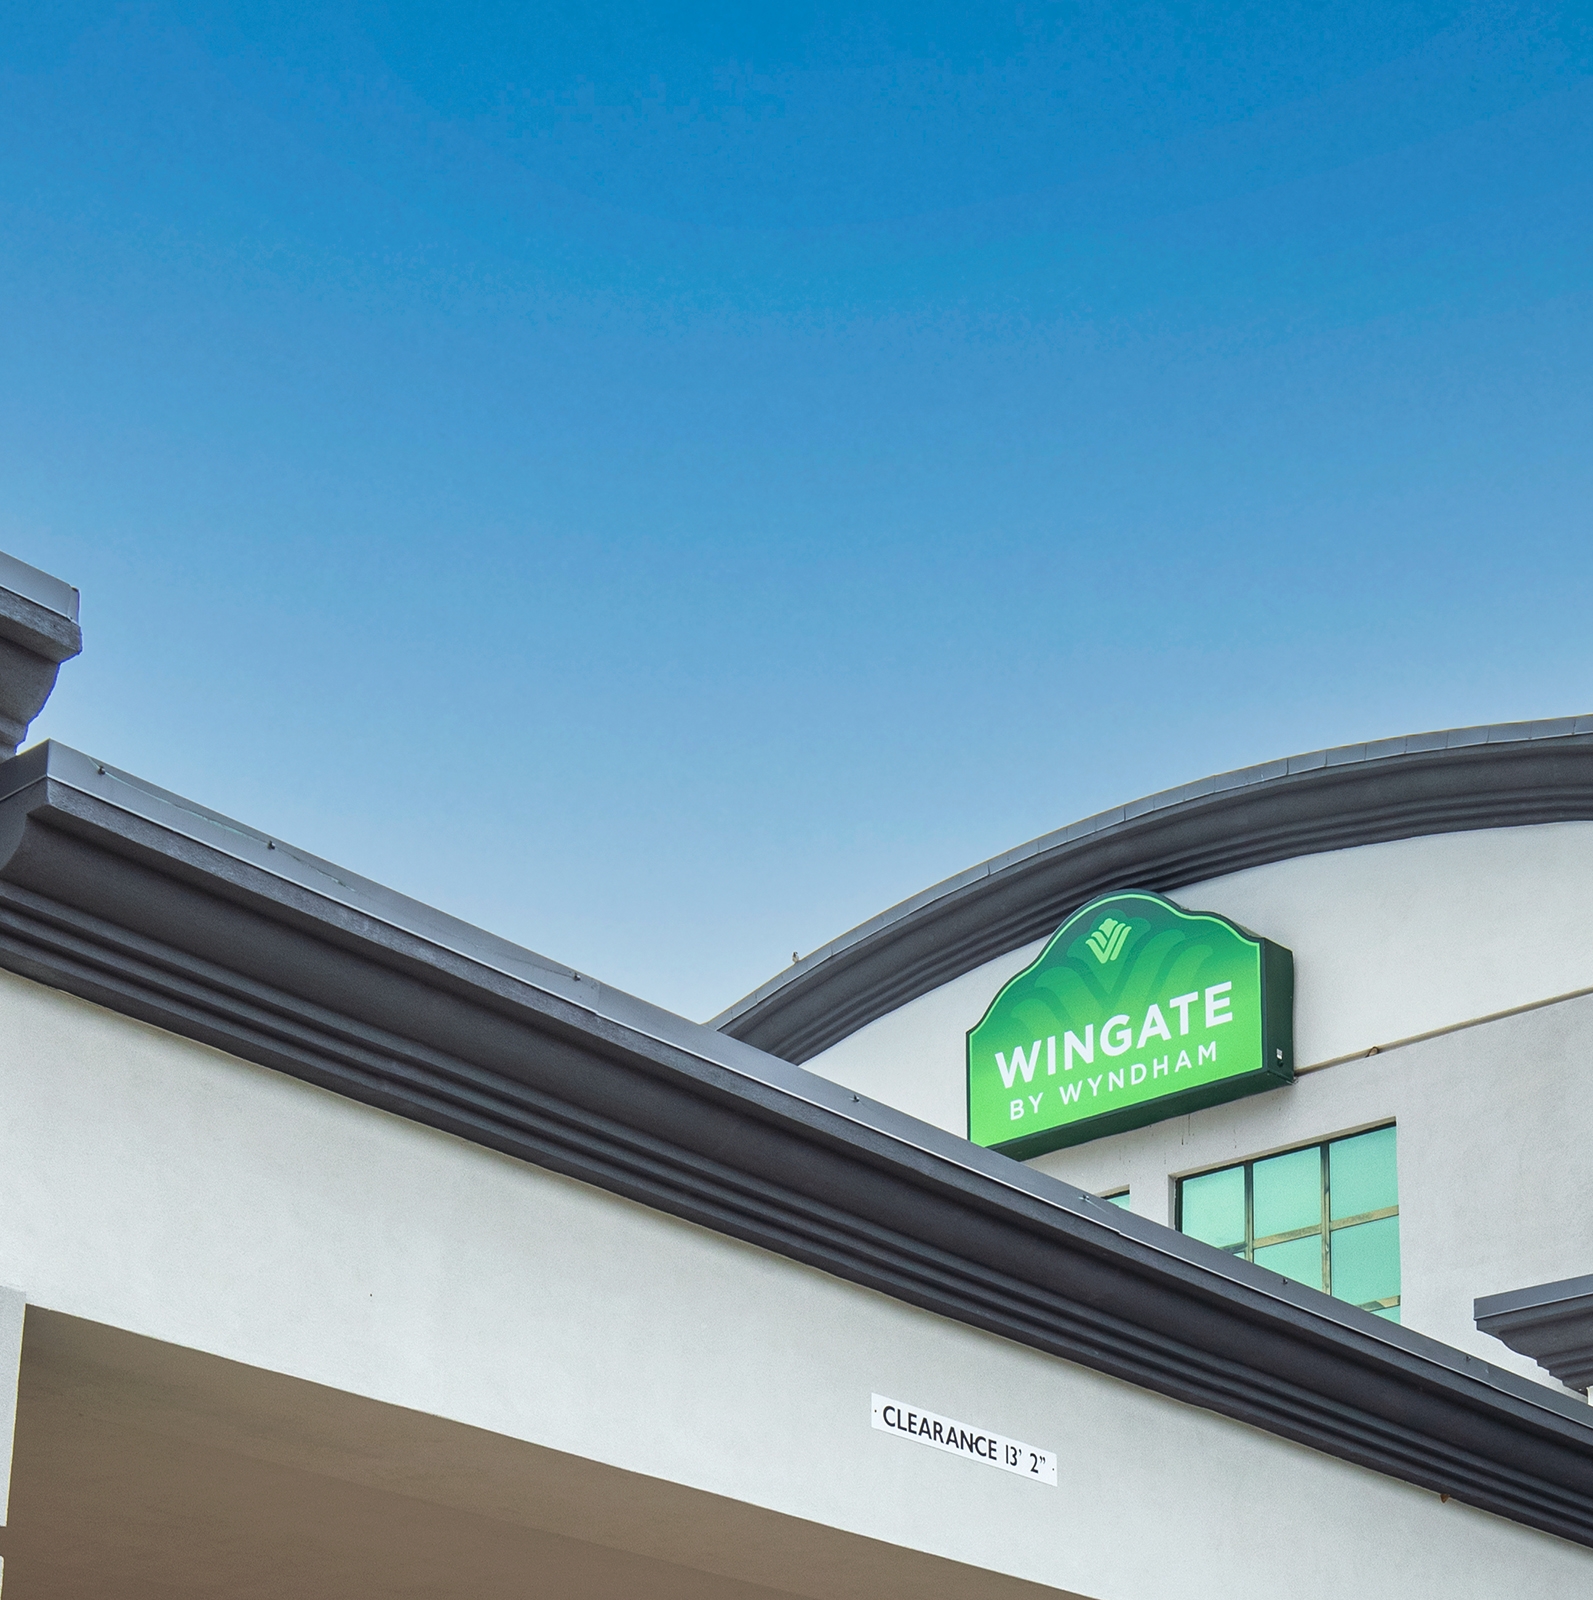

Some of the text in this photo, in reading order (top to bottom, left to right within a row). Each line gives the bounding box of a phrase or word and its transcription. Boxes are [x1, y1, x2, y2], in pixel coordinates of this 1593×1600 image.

[995, 981, 1233, 1089] WINGATE
[1010, 1040, 1217, 1121] BY WYNDHAM
[882, 1405, 998, 1461] CLEARANCE
